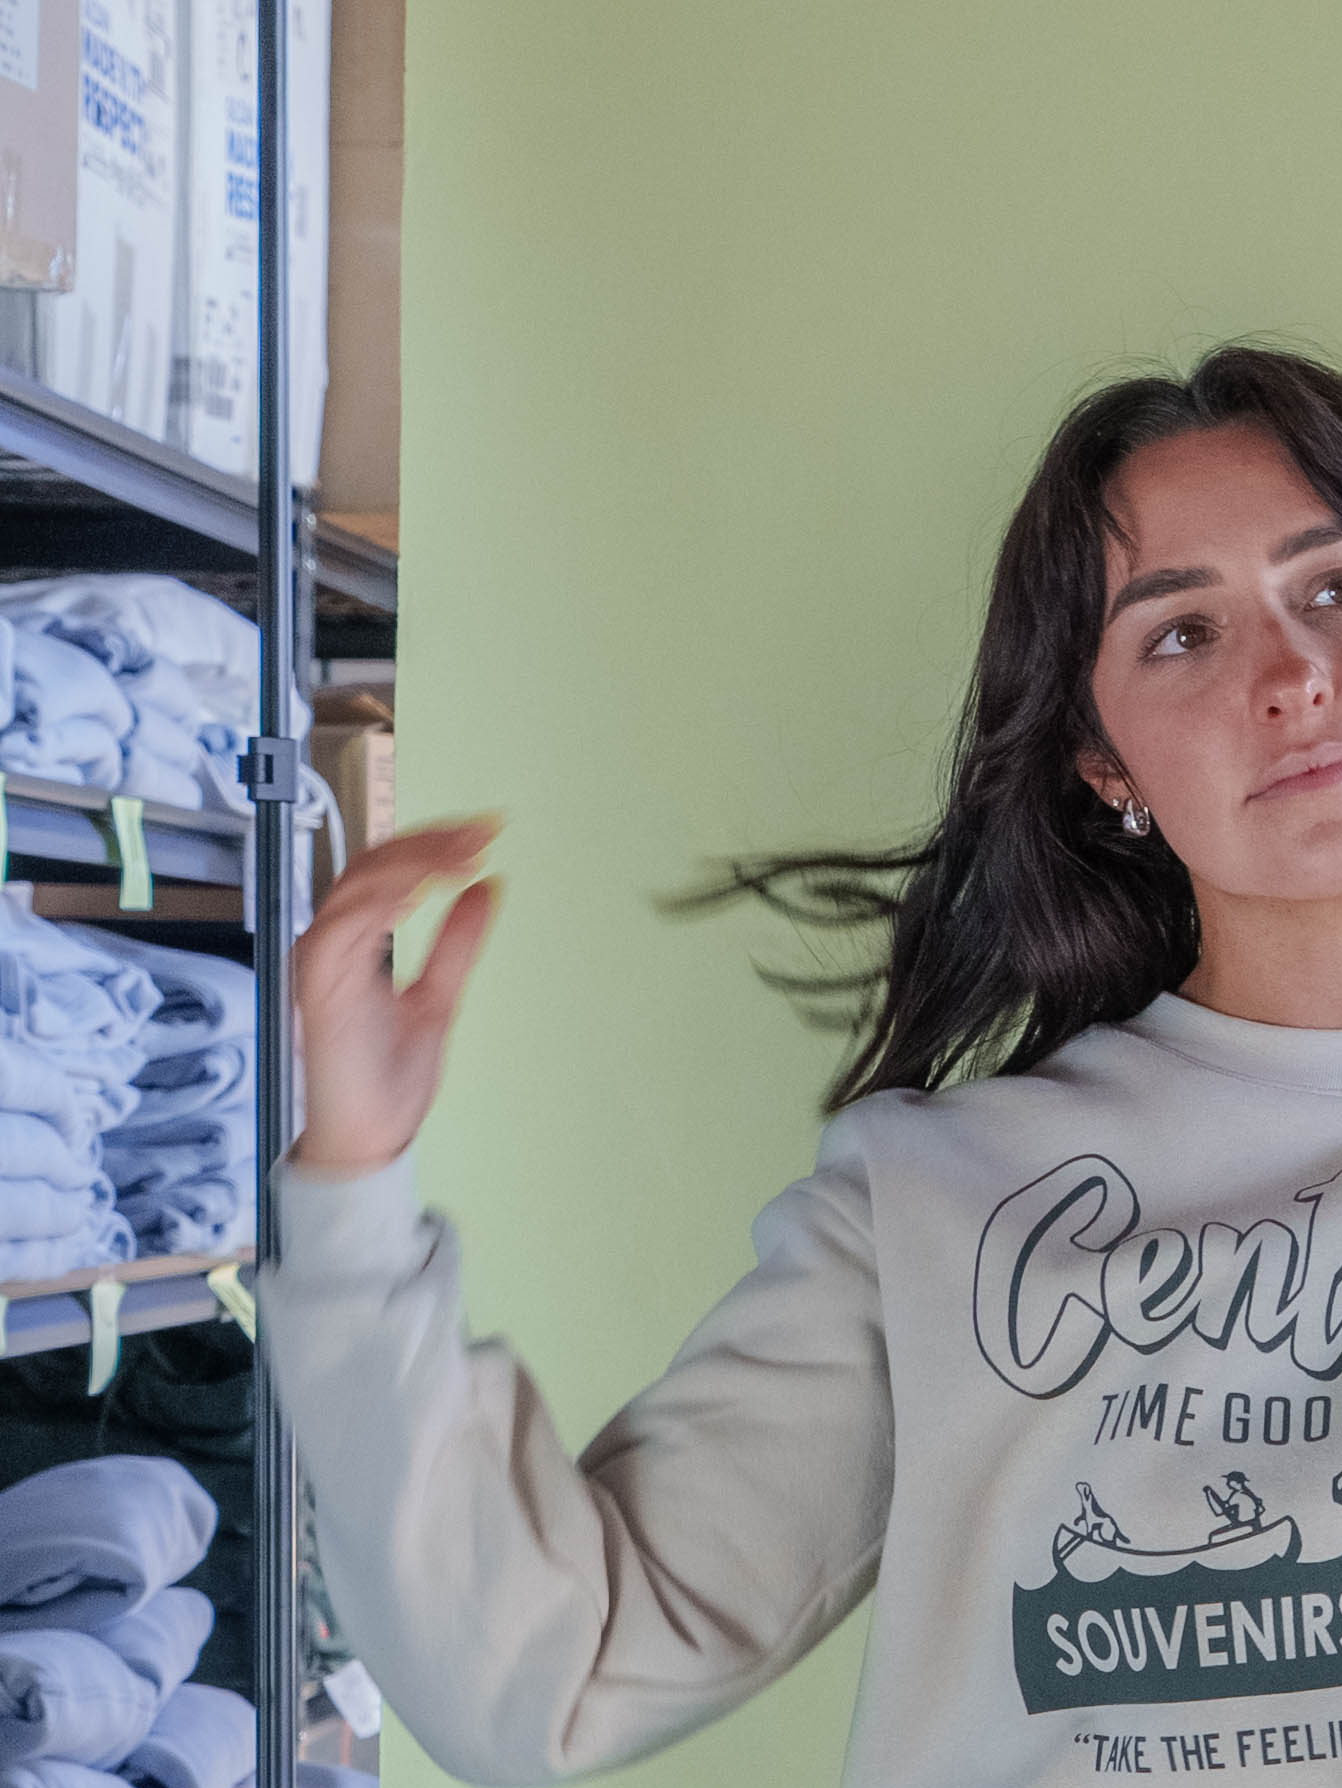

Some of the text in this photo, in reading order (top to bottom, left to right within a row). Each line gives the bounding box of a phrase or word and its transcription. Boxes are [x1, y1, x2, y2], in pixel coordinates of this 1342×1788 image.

[1093, 1383, 1204, 1446] TIME
[1073, 1731, 1152, 1774] “TAKE
[1160, 1732, 1226, 1772] THE
